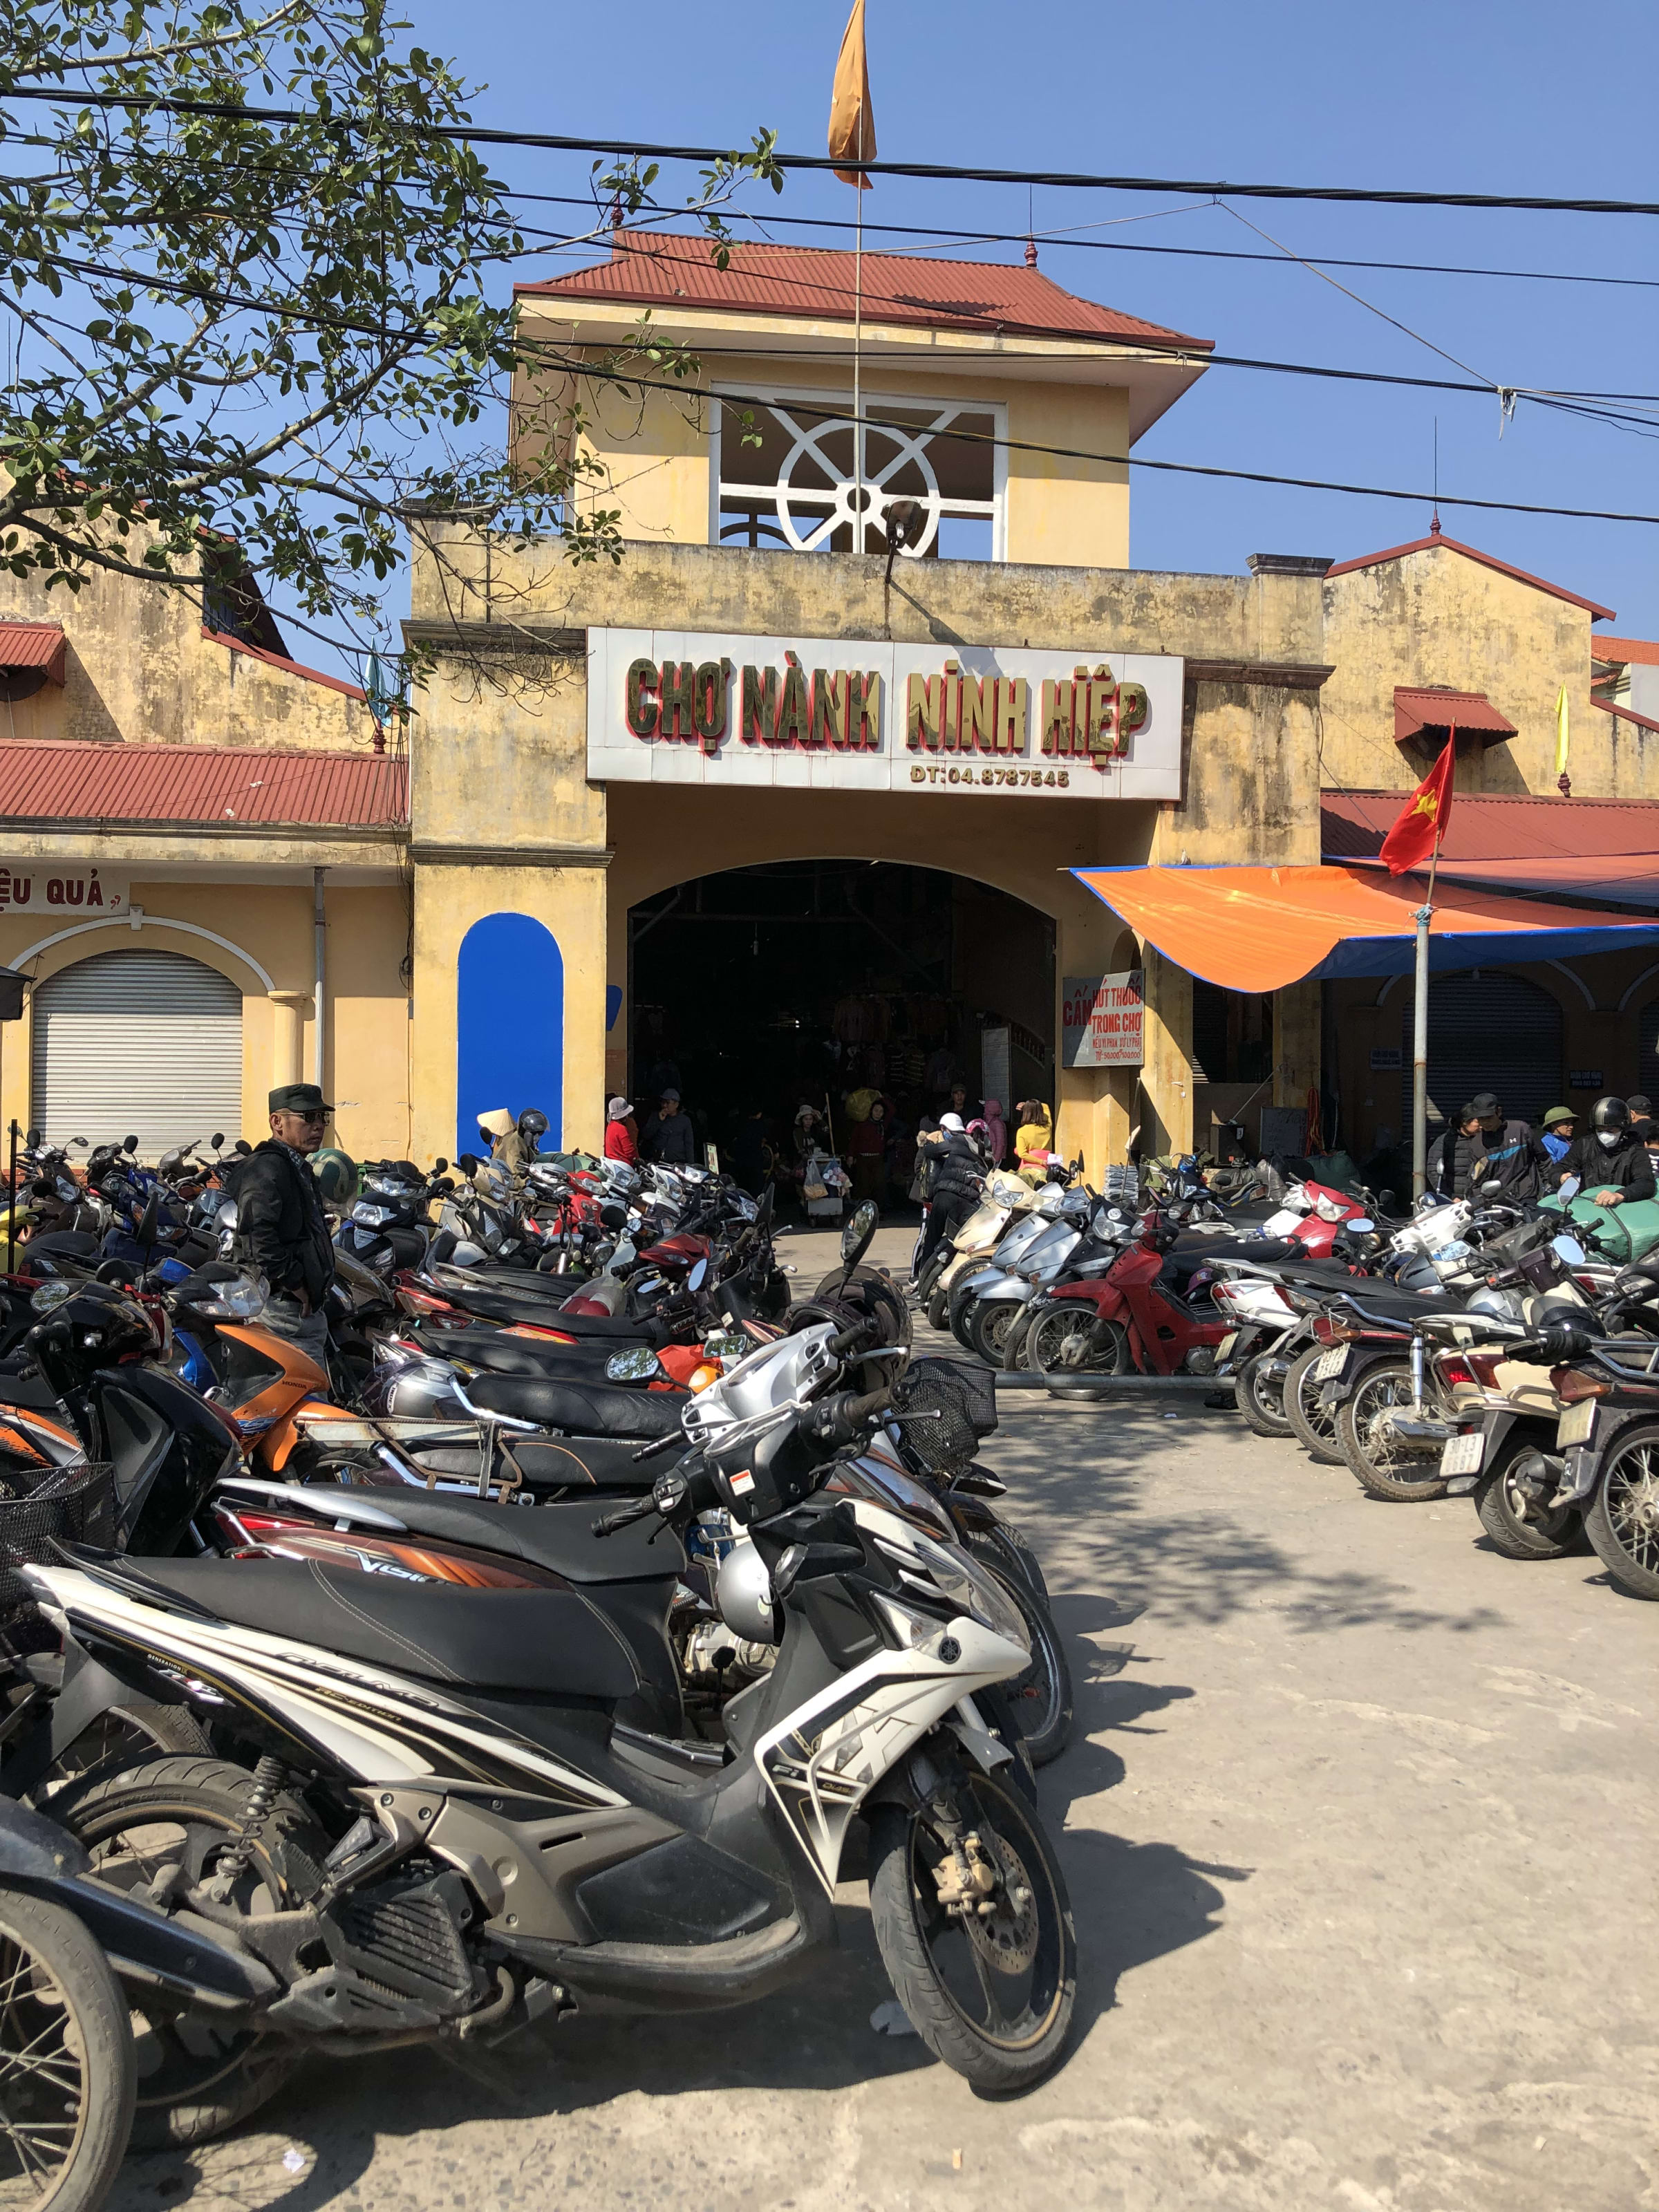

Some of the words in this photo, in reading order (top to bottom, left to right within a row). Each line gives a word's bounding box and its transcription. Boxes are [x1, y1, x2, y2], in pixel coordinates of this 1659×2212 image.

[624, 657, 731, 751] CHỢ
[741, 650, 880, 744] NÀNH
[910, 765, 1070, 787] ĐT:04.8787545
[1111, 975, 1141, 1006] THUỐC
[1062, 984, 1092, 1027] CẤM
[1092, 1013, 1120, 1035] TRONG
[1122, 1011, 1143, 1036] CHỢ
[282, 1380, 307, 1389] HONDA
[147, 1653, 182, 1671] GENERATION
